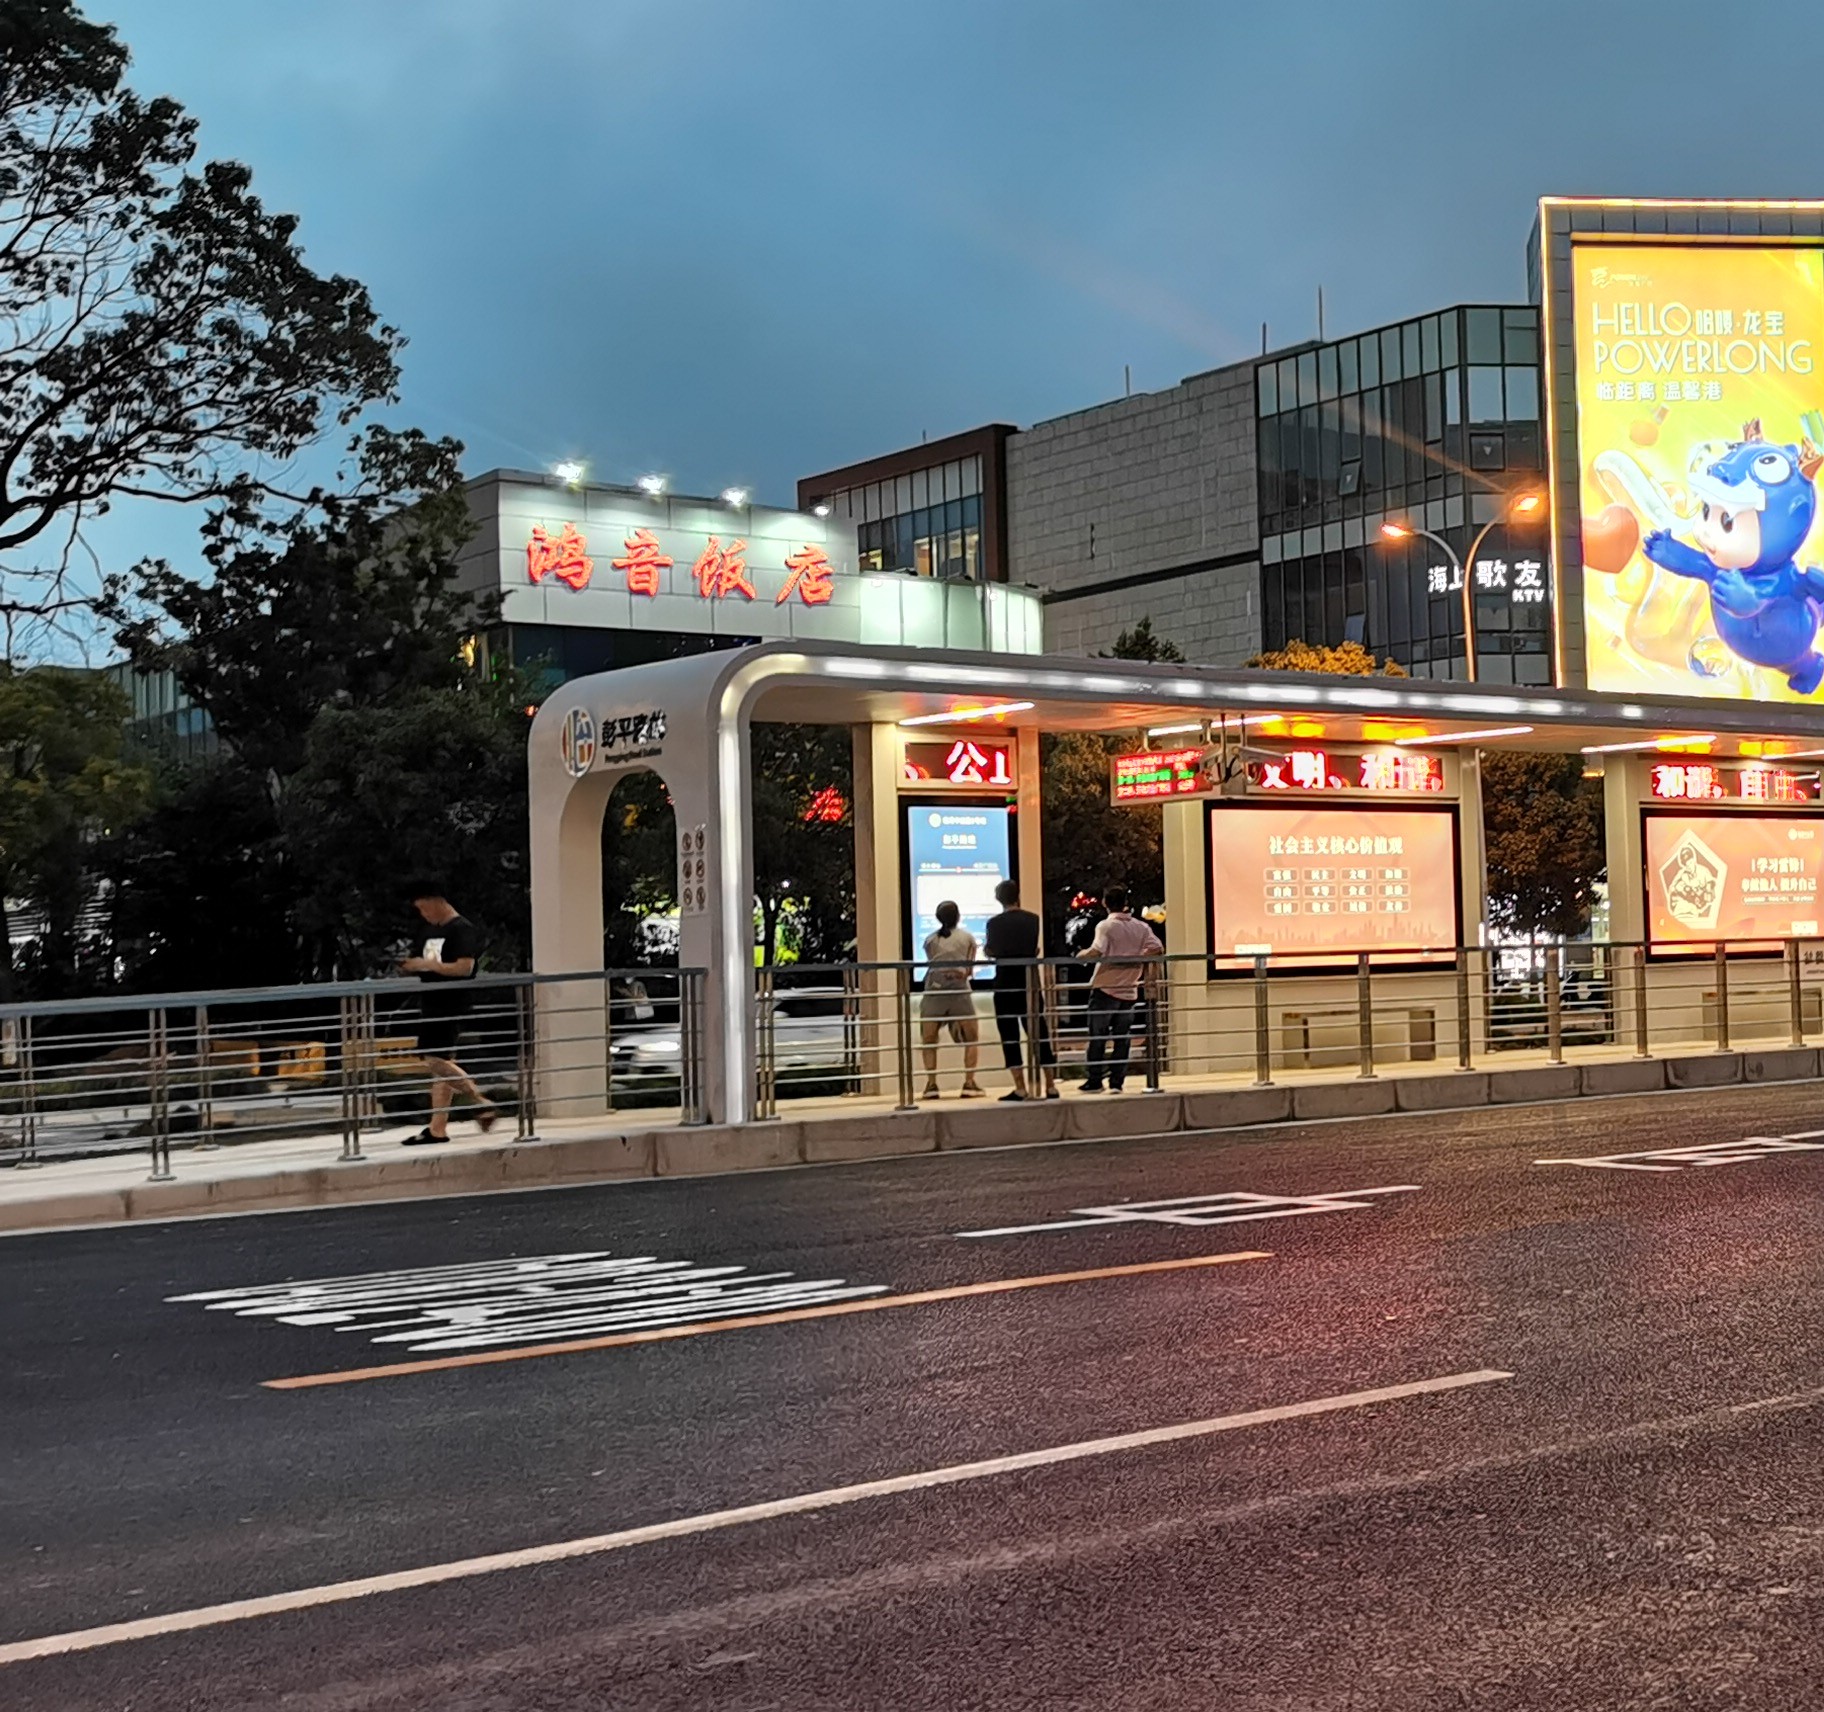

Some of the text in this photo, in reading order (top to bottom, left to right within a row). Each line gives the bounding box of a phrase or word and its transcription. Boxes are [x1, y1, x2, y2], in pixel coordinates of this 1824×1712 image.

[1591, 301, 1693, 337] HELLO
[1593, 338, 1814, 375] POWERLONG
[1596, 380, 1723, 402] 临距离 温馨港
[526, 521, 836, 606] 鸿音饭店
[1511, 588, 1545, 603] KTV
[1269, 835, 1403, 855] 社会主义核心价值观
